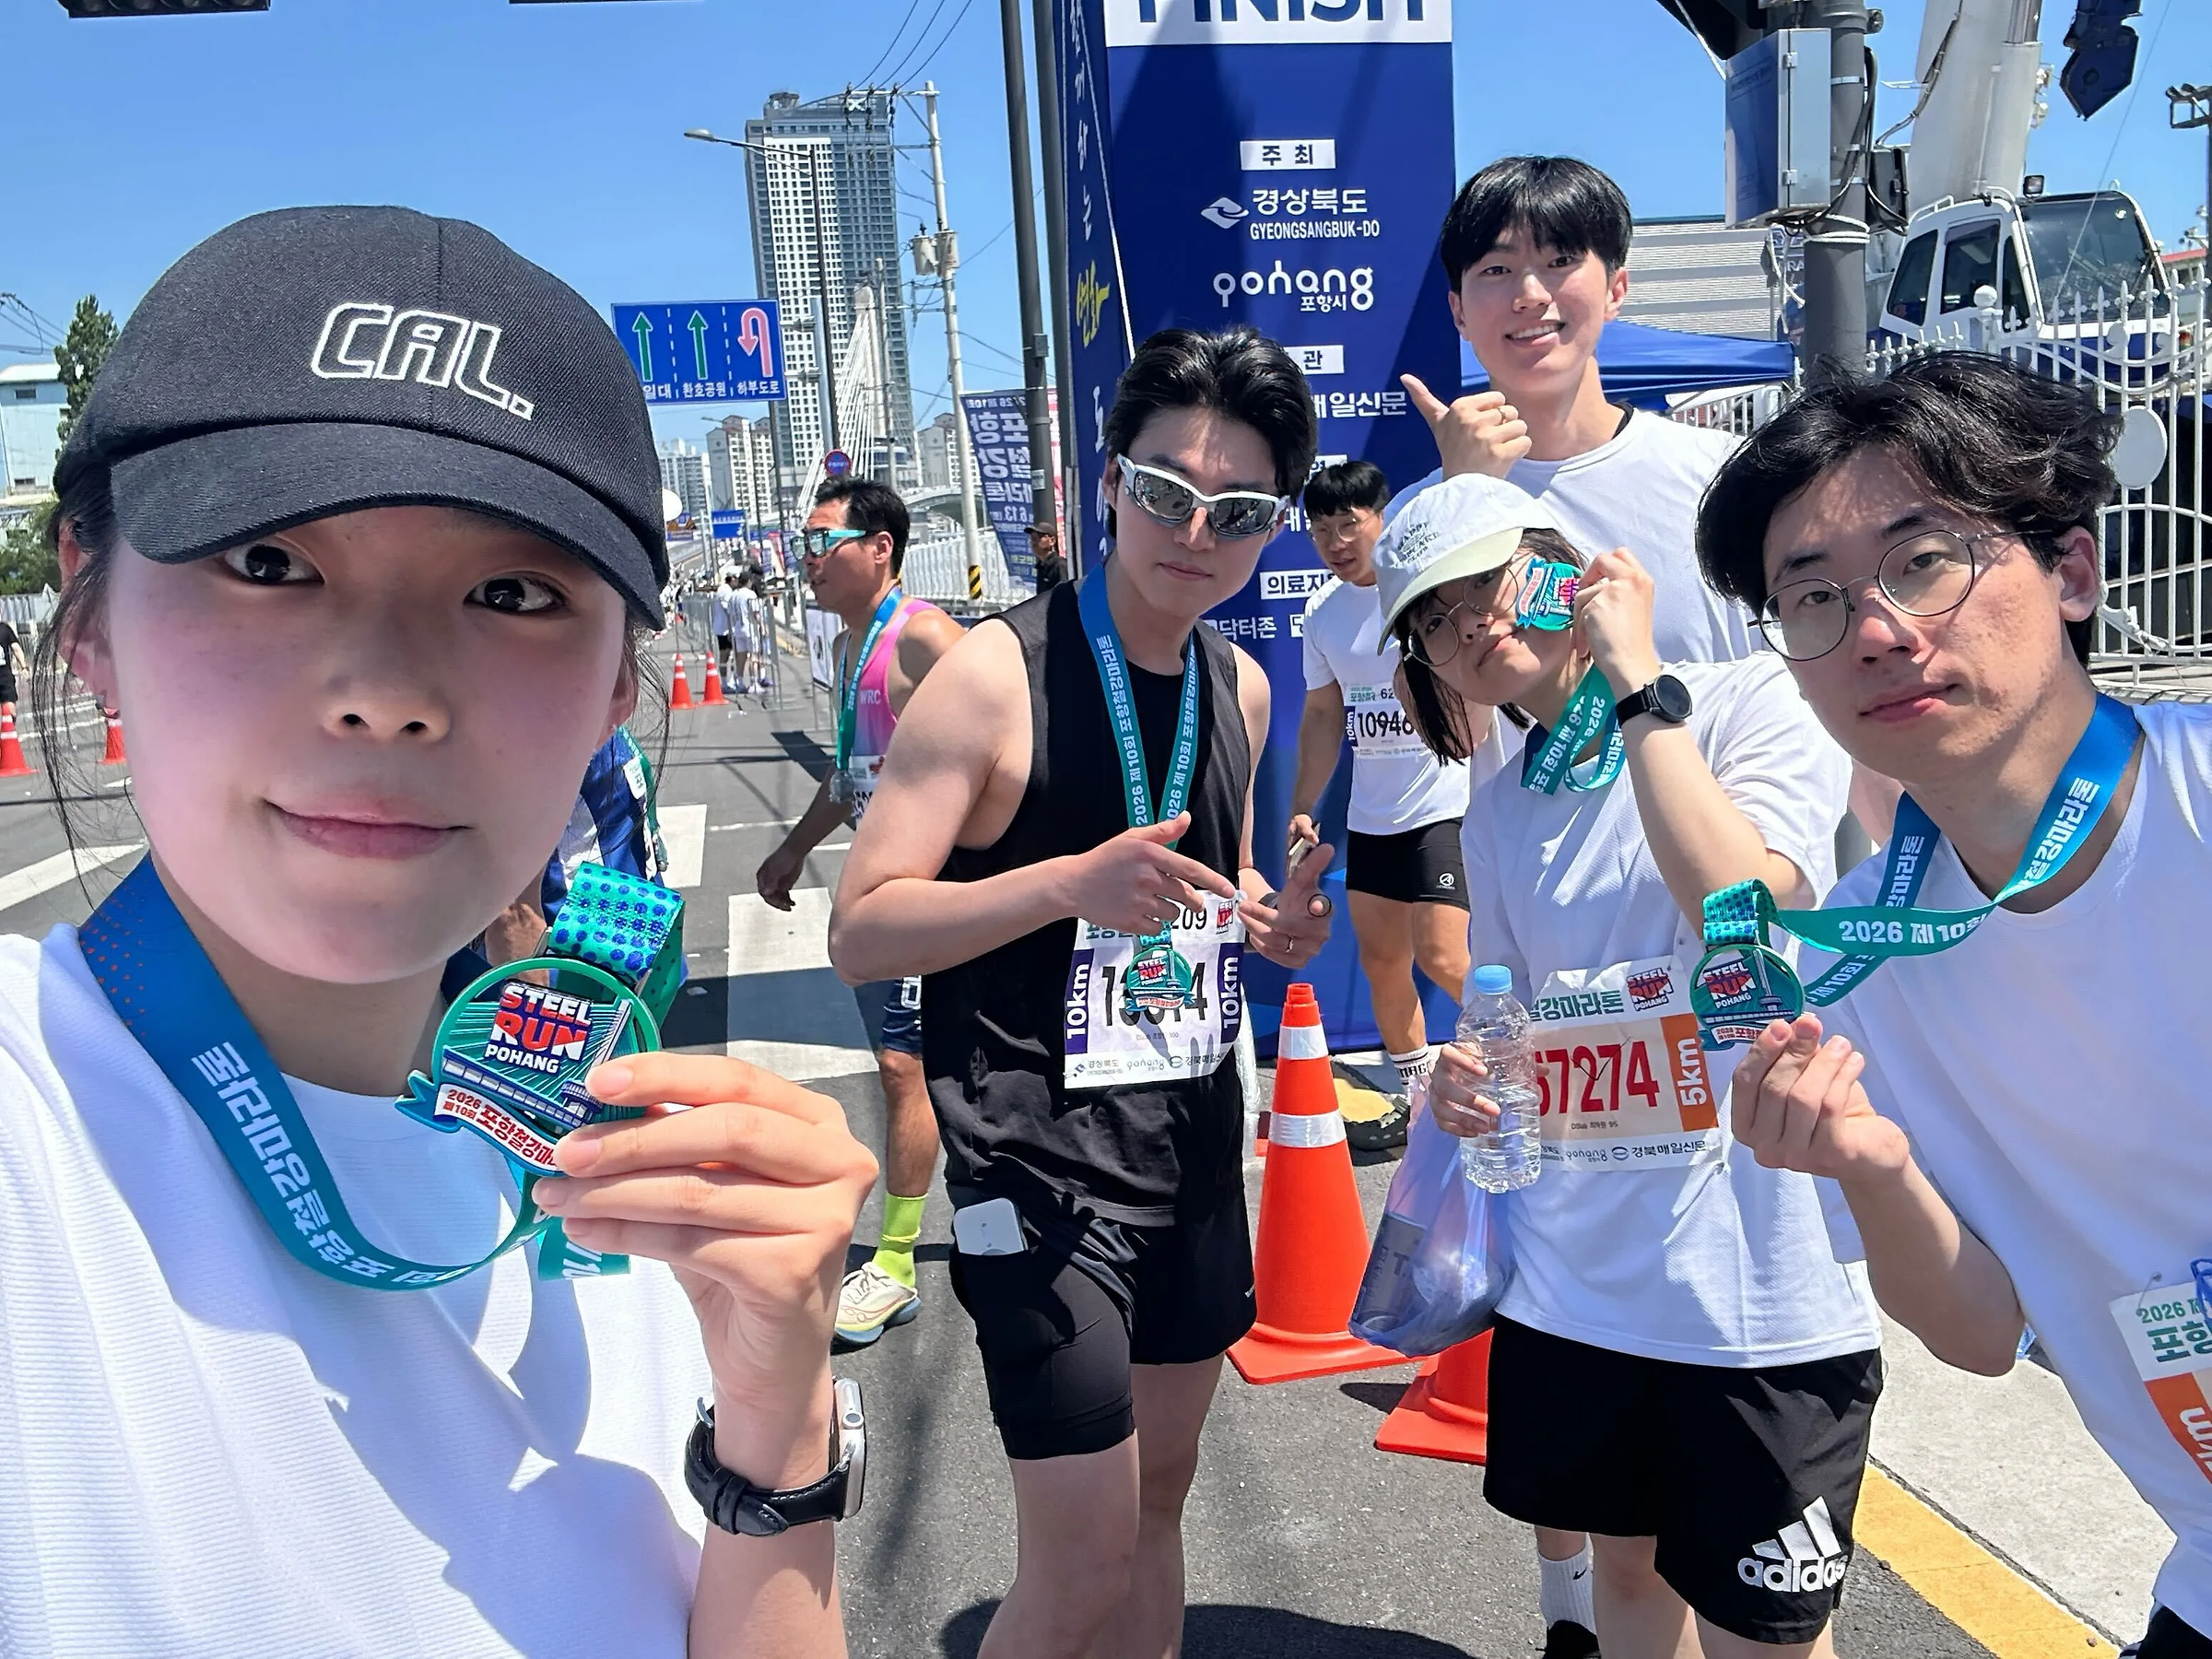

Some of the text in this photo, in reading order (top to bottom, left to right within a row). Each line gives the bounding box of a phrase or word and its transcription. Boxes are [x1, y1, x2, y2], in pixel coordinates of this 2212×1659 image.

[1253, 189, 1368, 216] 경상북도
[1250, 220, 1380, 240] GYEONGSANGBUK-DO
[1213, 261, 1374, 312] pohang
[1300, 295, 1347, 312] 포항시
[311, 302, 535, 420] CAL.
[682, 382, 726, 398] 환호공원
[737, 380, 781, 395] 하부도로
[1267, 573, 1335, 594] 의료지
[1097, 634, 1133, 733] 포항철강마라톤
[859, 690, 881, 704] WRC
[1584, 697, 1606, 736] 2026
[1132, 785, 1148, 826] 2026
[1167, 789, 1182, 820] 026
[1839, 920, 1904, 944] 2026
[1626, 968, 1667, 988] STEEL
[1703, 961, 1748, 982] STEEL
[1220, 957, 1240, 1029] 10km
[1629, 979, 1674, 1003] RUN
[1707, 974, 1757, 1000] RUN
[500, 984, 593, 1028] STEEL
[1067, 964, 1089, 1040] 10km
[1635, 995, 1669, 1011] POHANG
[1714, 993, 1751, 1009] POHANG
[489, 1009, 588, 1061] RUN
[485, 1044, 561, 1075] POHANG
[1677, 1038, 1707, 1107] 5km
[447, 1088, 482, 1109] 2026
[192, 1041, 395, 1278] 포항철강마라톤
[1631, 1140, 1705, 1159] 경북매일신문
[2141, 1301, 2186, 1324] 2026
[1737, 1554, 1849, 1593] adidas
